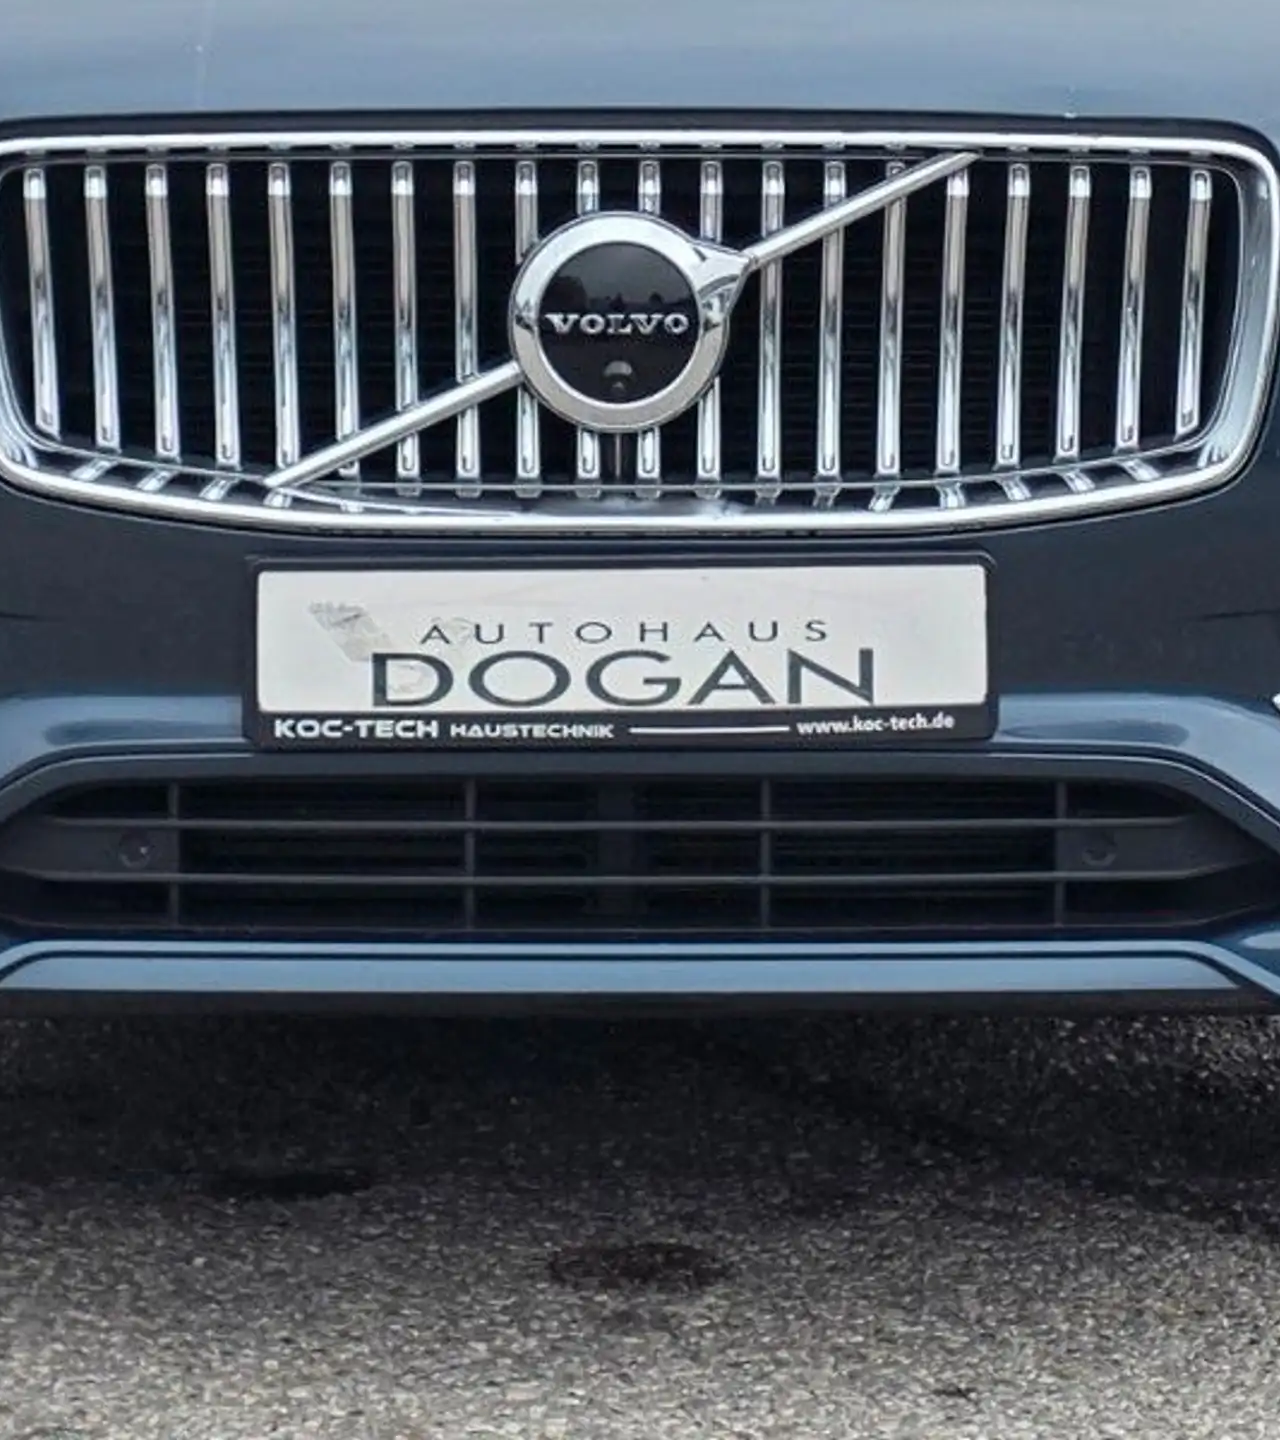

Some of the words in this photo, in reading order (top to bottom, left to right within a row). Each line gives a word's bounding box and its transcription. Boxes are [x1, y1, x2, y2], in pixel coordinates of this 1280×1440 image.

[544, 312, 690, 336] VOLVO
[420, 618, 828, 645] AUTOHAUS
[371, 647, 875, 708] DOGAN
[273, 718, 439, 740] KOC-TECH
[449, 722, 615, 740] HAUSTECHNIK
[795, 711, 956, 735] www.koc-tech.de
